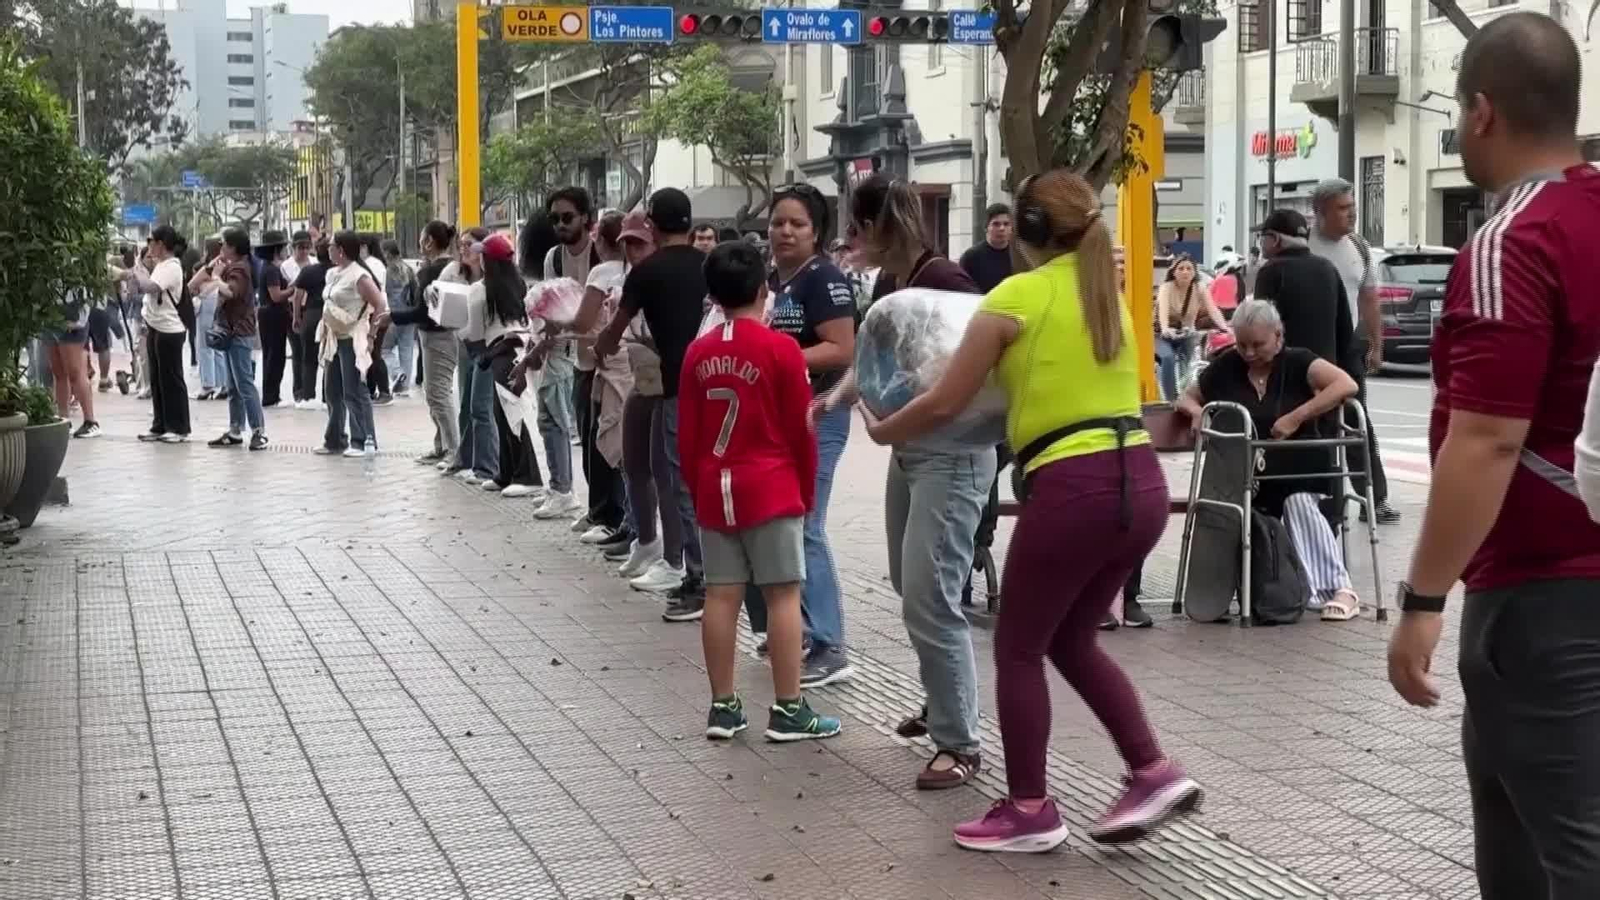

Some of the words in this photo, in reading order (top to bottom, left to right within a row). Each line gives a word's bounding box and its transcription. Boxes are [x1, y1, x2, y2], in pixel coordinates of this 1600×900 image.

[517, 9, 547, 21] OLA
[594, 10, 620, 27] Psje.
[787, 12, 814, 26] Ovalo
[818, 12, 830, 26] de
[507, 25, 558, 36] VERDE
[595, 24, 614, 37] Los
[620, 24, 663, 38] Pintores
[787, 27, 836, 41] Miraflores
[695, 355, 761, 385] RONALDO
[706, 387, 740, 459] 7
